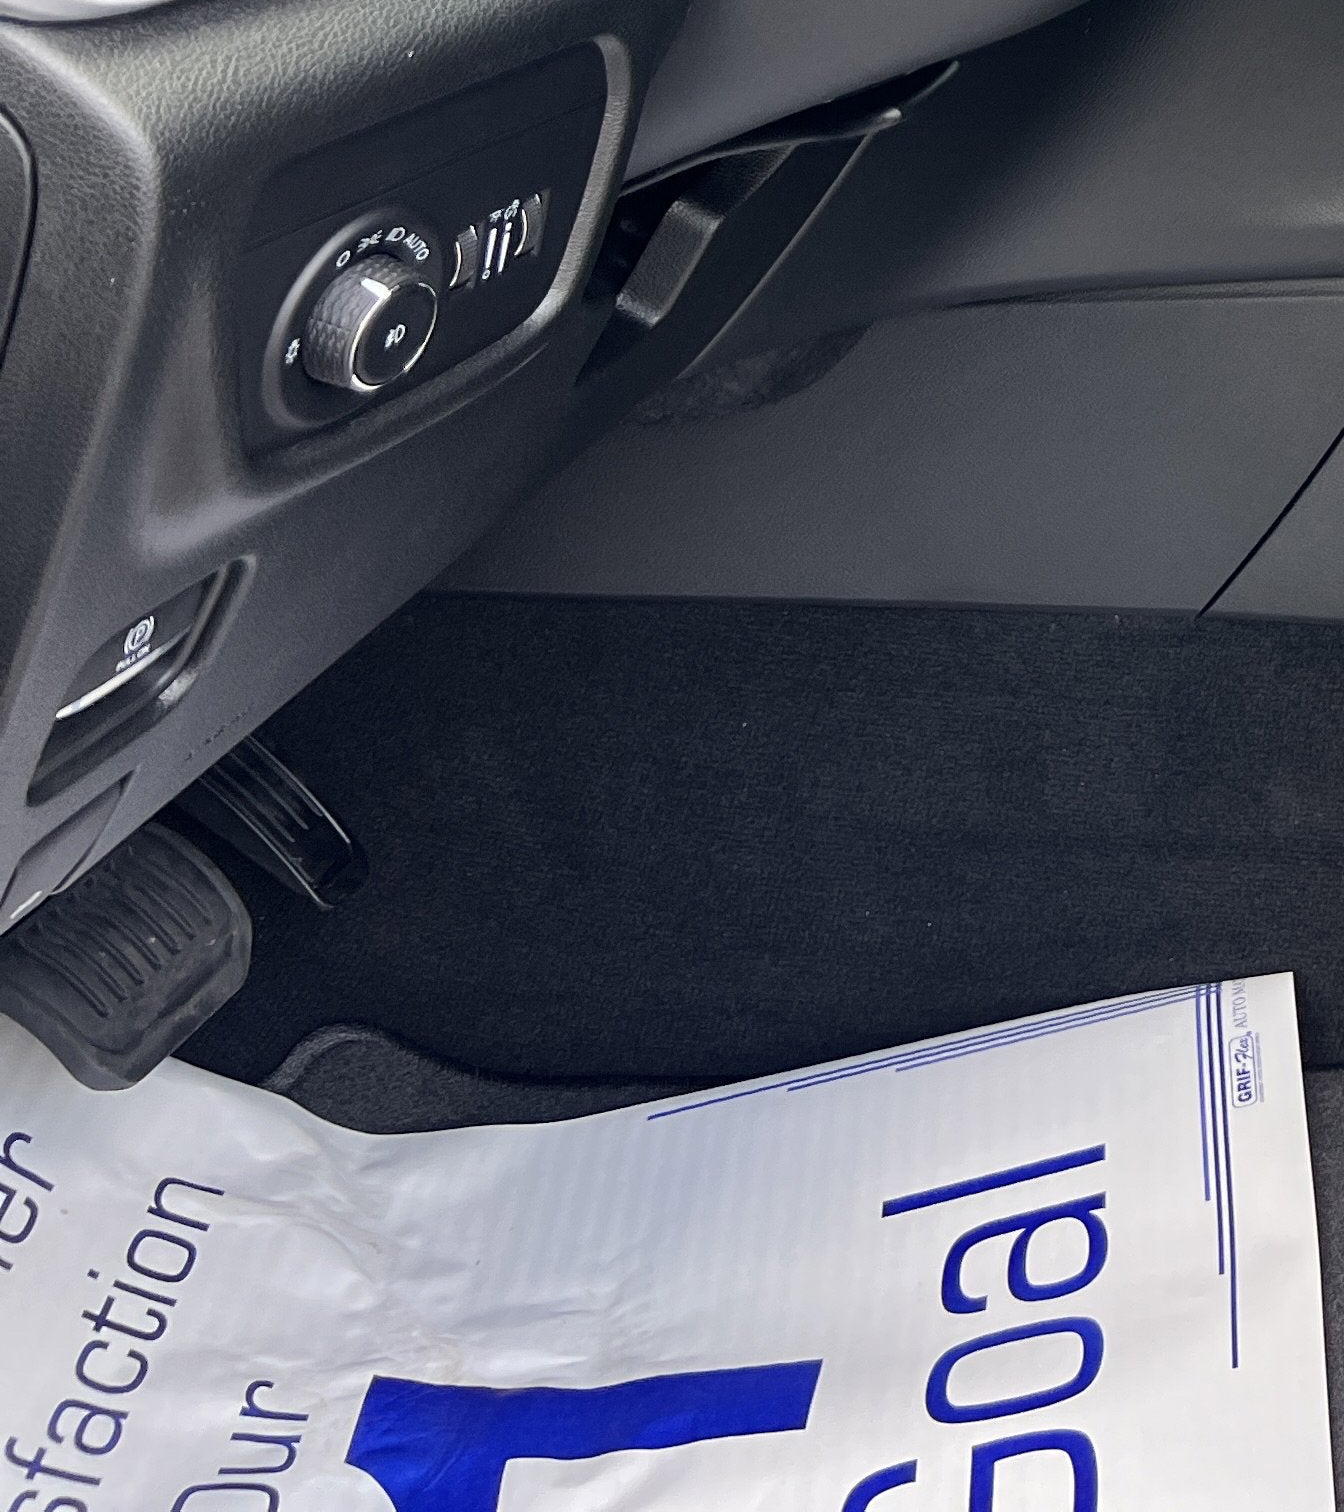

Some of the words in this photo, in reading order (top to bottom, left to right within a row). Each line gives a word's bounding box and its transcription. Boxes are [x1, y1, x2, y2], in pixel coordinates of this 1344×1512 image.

[402, 232, 430, 262] AUTO
[1232, 997, 1248, 1028] AUTO
[0, 1131, 55, 1271] er
[841, 1144, 1108, 1512] Goal
